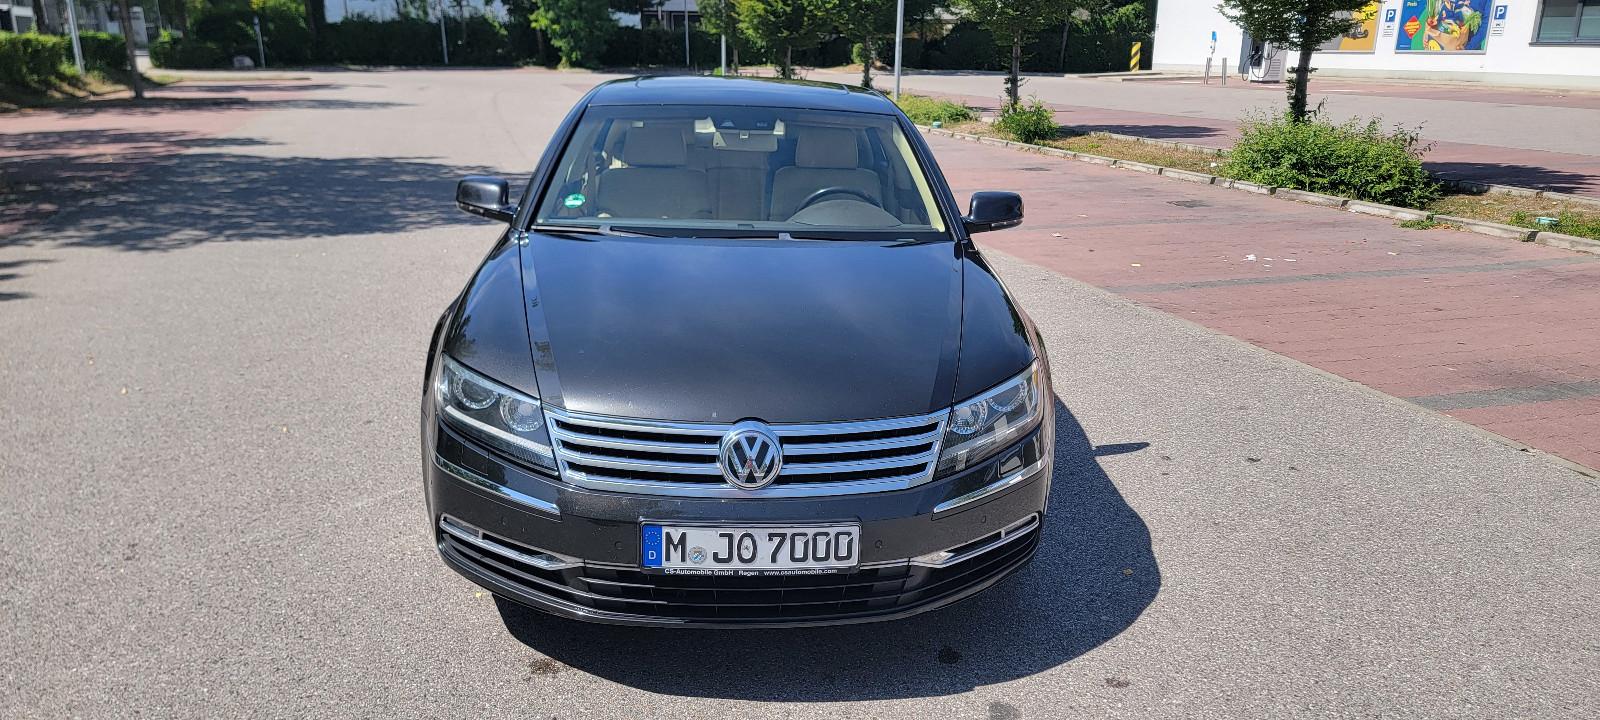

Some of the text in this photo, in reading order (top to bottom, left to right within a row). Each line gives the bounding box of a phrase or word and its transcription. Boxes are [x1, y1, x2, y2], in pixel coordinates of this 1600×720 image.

[1387, 10, 1395, 21] P
[1496, 6, 1505, 19] P
[724, 430, 779, 487] VW
[664, 531, 854, 564] M JO 7000
[648, 550, 657, 560] D
